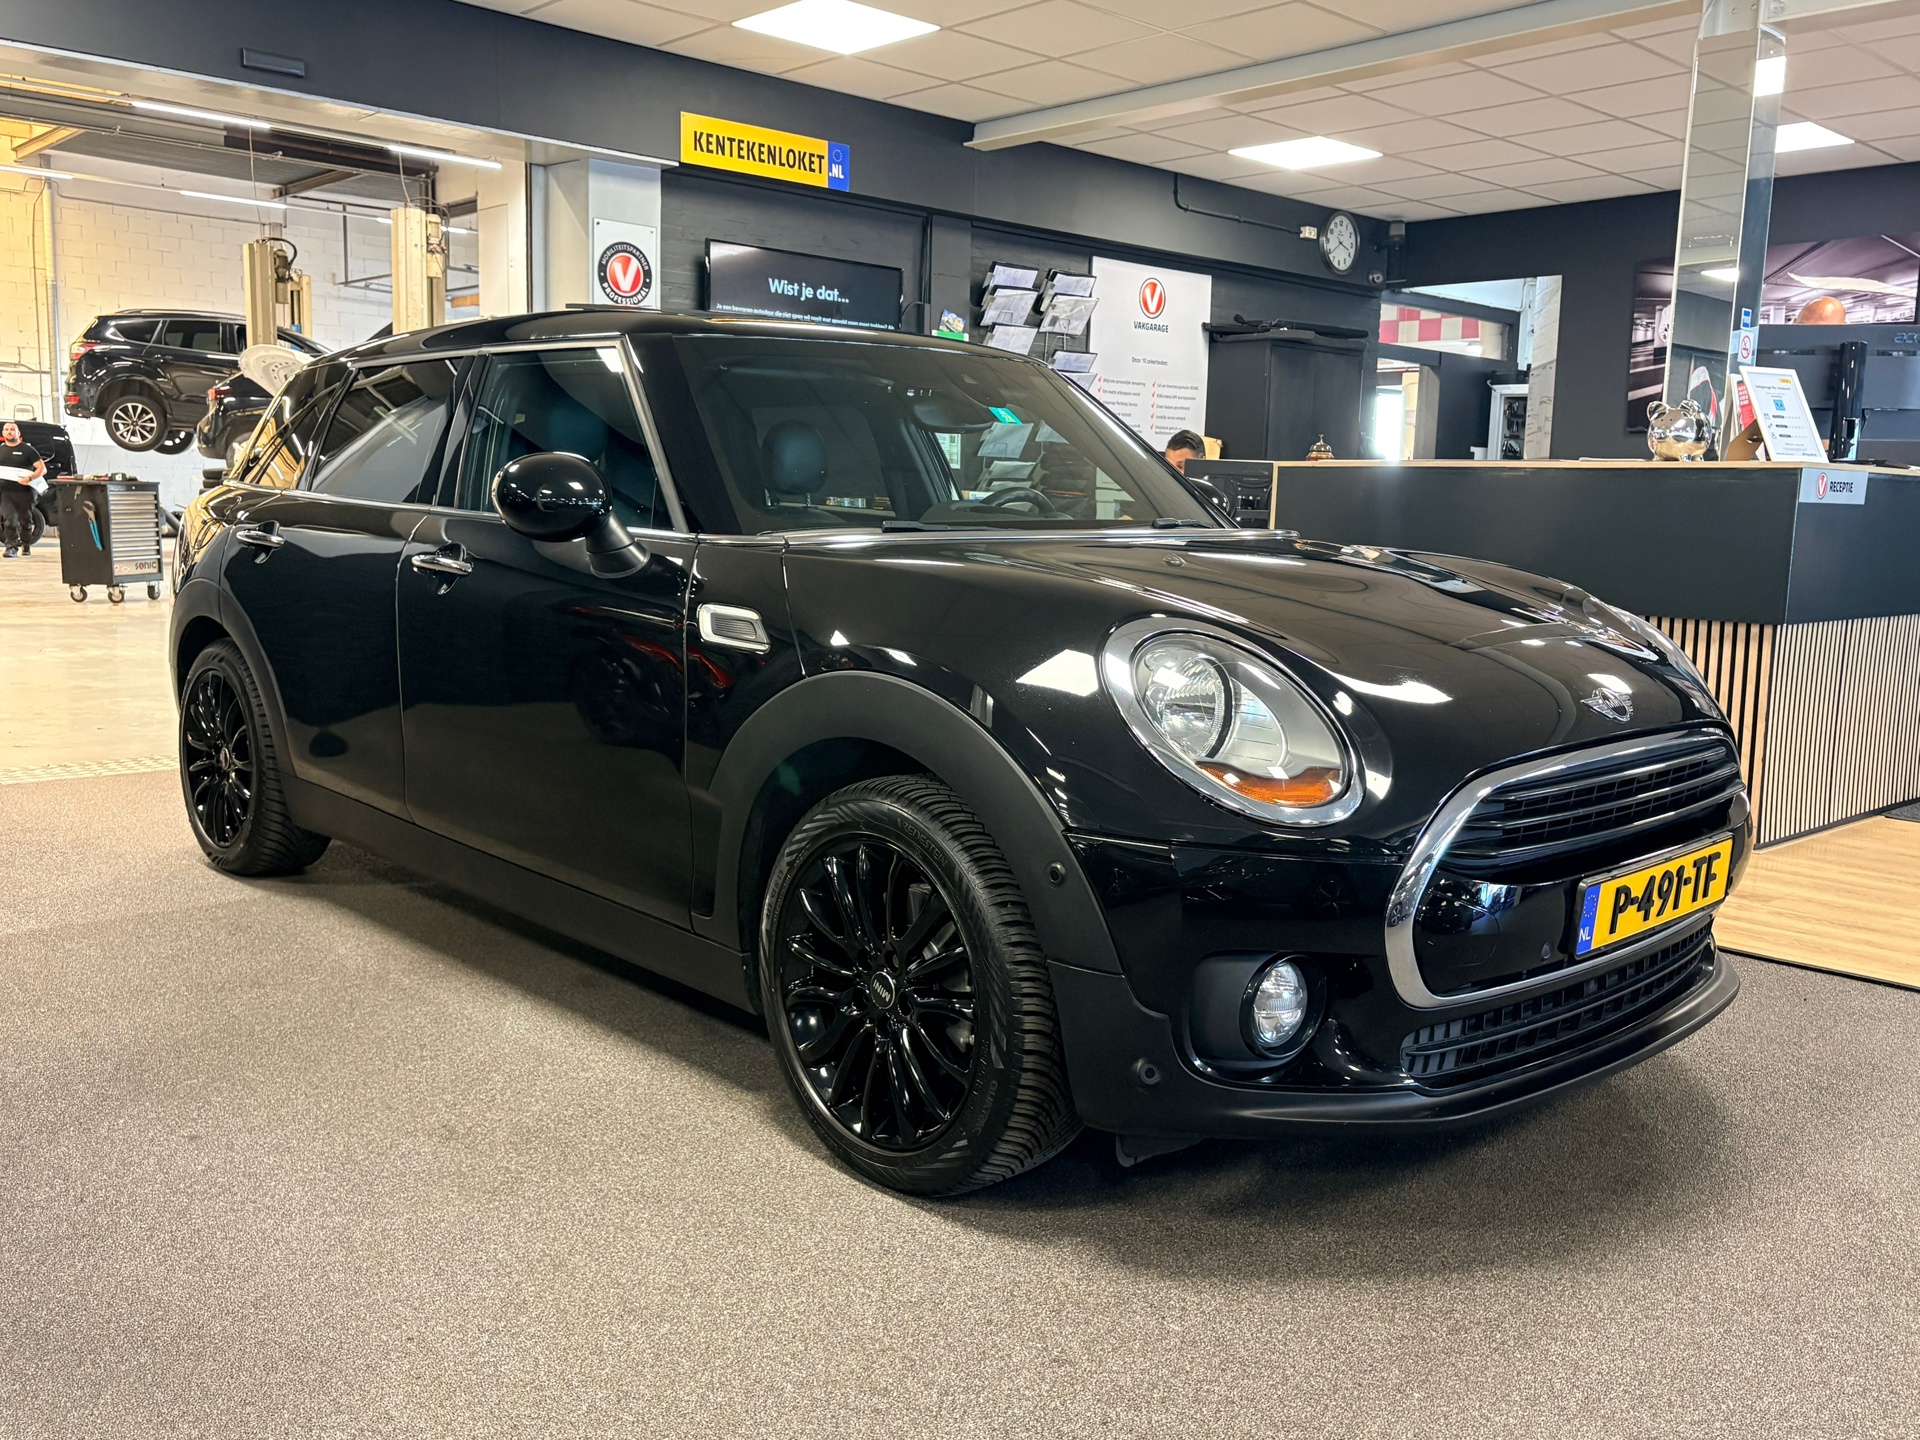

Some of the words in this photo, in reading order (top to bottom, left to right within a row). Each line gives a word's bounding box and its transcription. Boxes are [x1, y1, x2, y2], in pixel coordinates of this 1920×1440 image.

[694, 130, 825, 174] KENTEKENLOKET
[601, 243, 650, 271] MOBILITEITSPARTNER
[601, 282, 649, 305] PROFESSIONAL
[768, 277, 800, 296] Wist
[801, 282, 814, 301] je
[816, 285, 849, 303] dat...
[1133, 321, 1169, 333] VAKGARAGE
[1829, 481, 1854, 493] RECEPTIE
[896, 817, 948, 867] VREDESTEIN
[1609, 851, 1721, 935] P-491-TF
[1578, 926, 1591, 943] NL
[873, 979, 891, 1003] MINI
